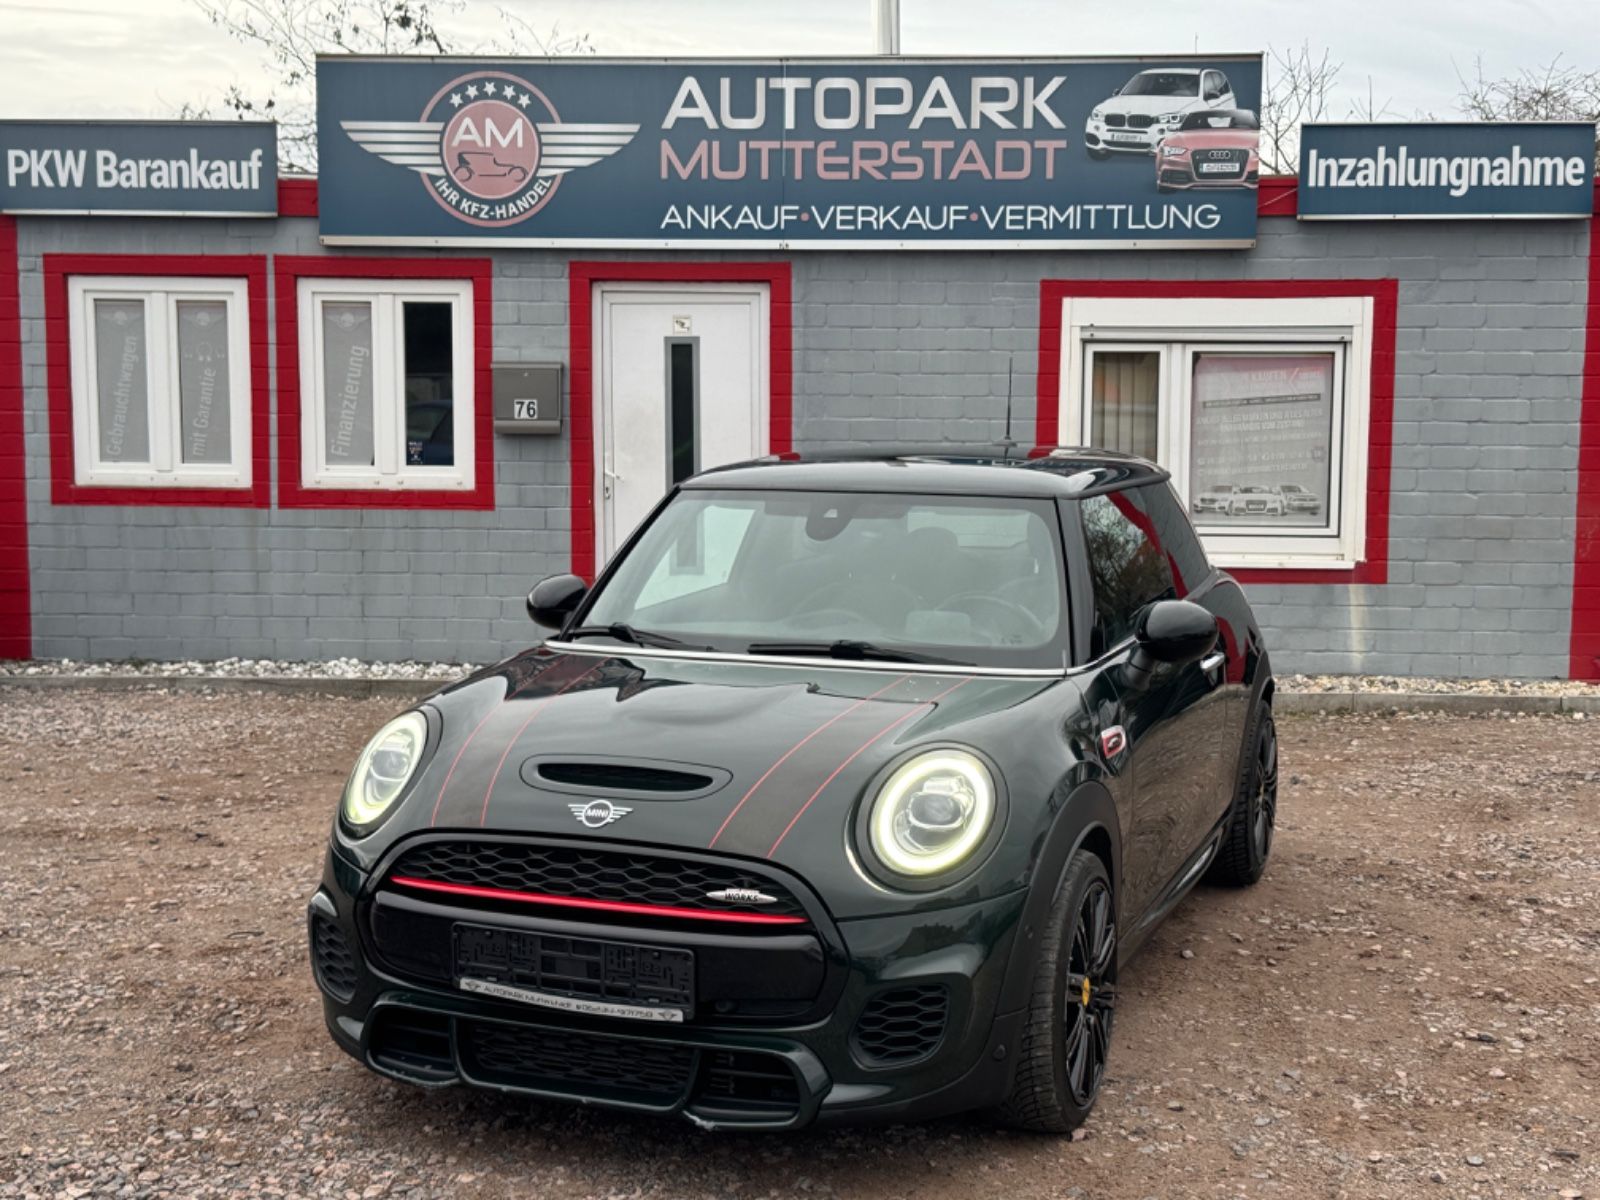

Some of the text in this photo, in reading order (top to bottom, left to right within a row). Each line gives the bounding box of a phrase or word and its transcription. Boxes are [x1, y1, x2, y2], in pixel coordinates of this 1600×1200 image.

[661, 75, 1067, 130] AUTOPARK
[451, 116, 523, 148] AM
[7, 148, 263, 190] PKW Barankauf
[660, 139, 1067, 180] MUTTERSTADT
[1308, 145, 1585, 197] Inzahlungnahme
[434, 178, 552, 219] IHR KFZ-HANDEL
[660, 204, 1221, 230] ANKAUF VERKAUF VERMITTLUNG
[106, 335, 139, 456] Gebrauchtwagen
[190, 367, 216, 456] mit Garantie
[330, 344, 371, 457] Finanzierung
[514, 401, 536, 418] 76
[586, 808, 610, 818] MINI
